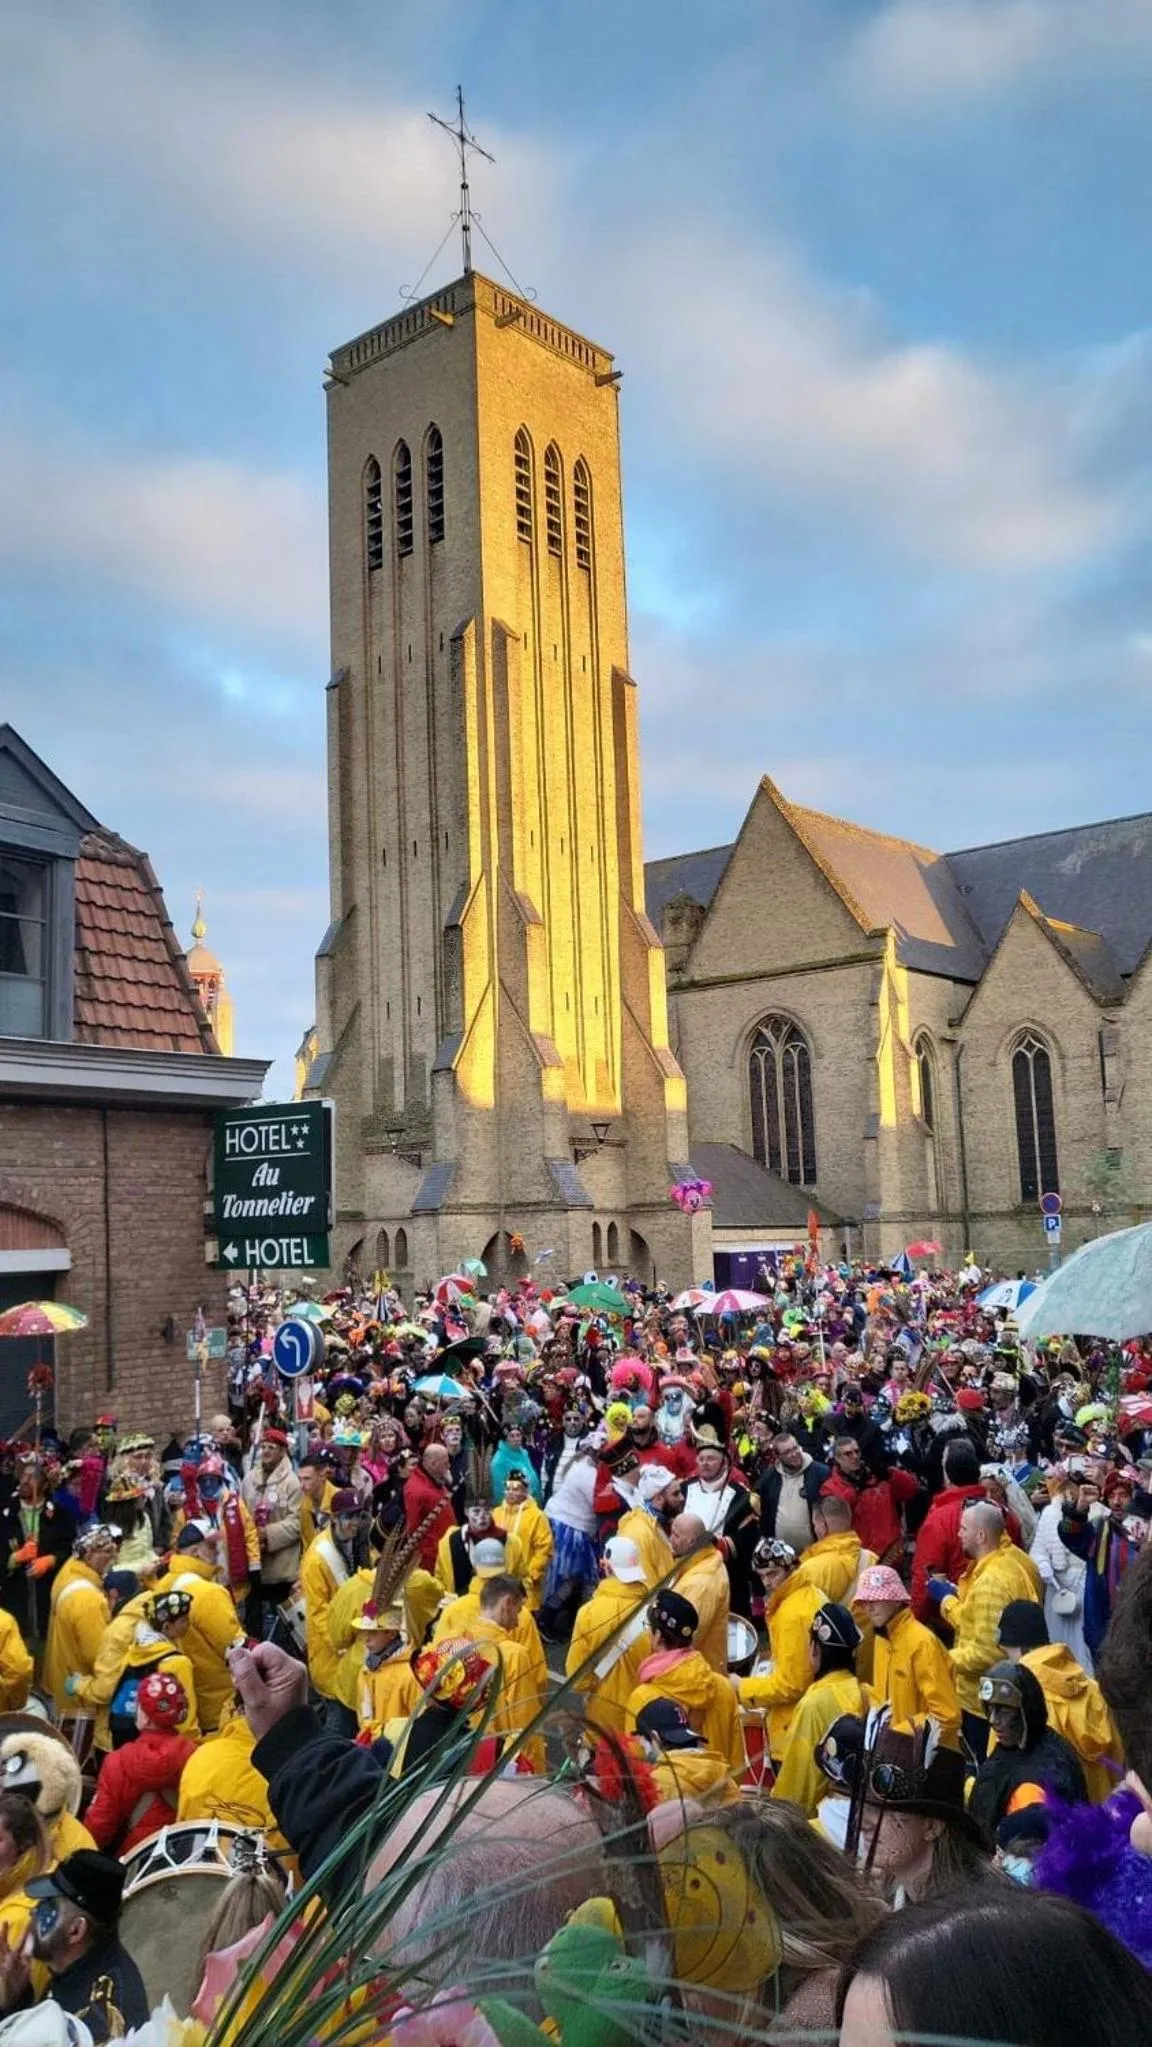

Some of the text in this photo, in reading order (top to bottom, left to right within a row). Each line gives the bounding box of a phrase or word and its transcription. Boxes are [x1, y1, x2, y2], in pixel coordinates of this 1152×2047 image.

[226, 1124, 291, 1154] HOTEL
[252, 1162, 280, 1187] Au
[222, 1191, 315, 1218] Tonnelier
[1048, 1218, 1056, 1229] P
[245, 1238, 314, 1265] HOTEL
